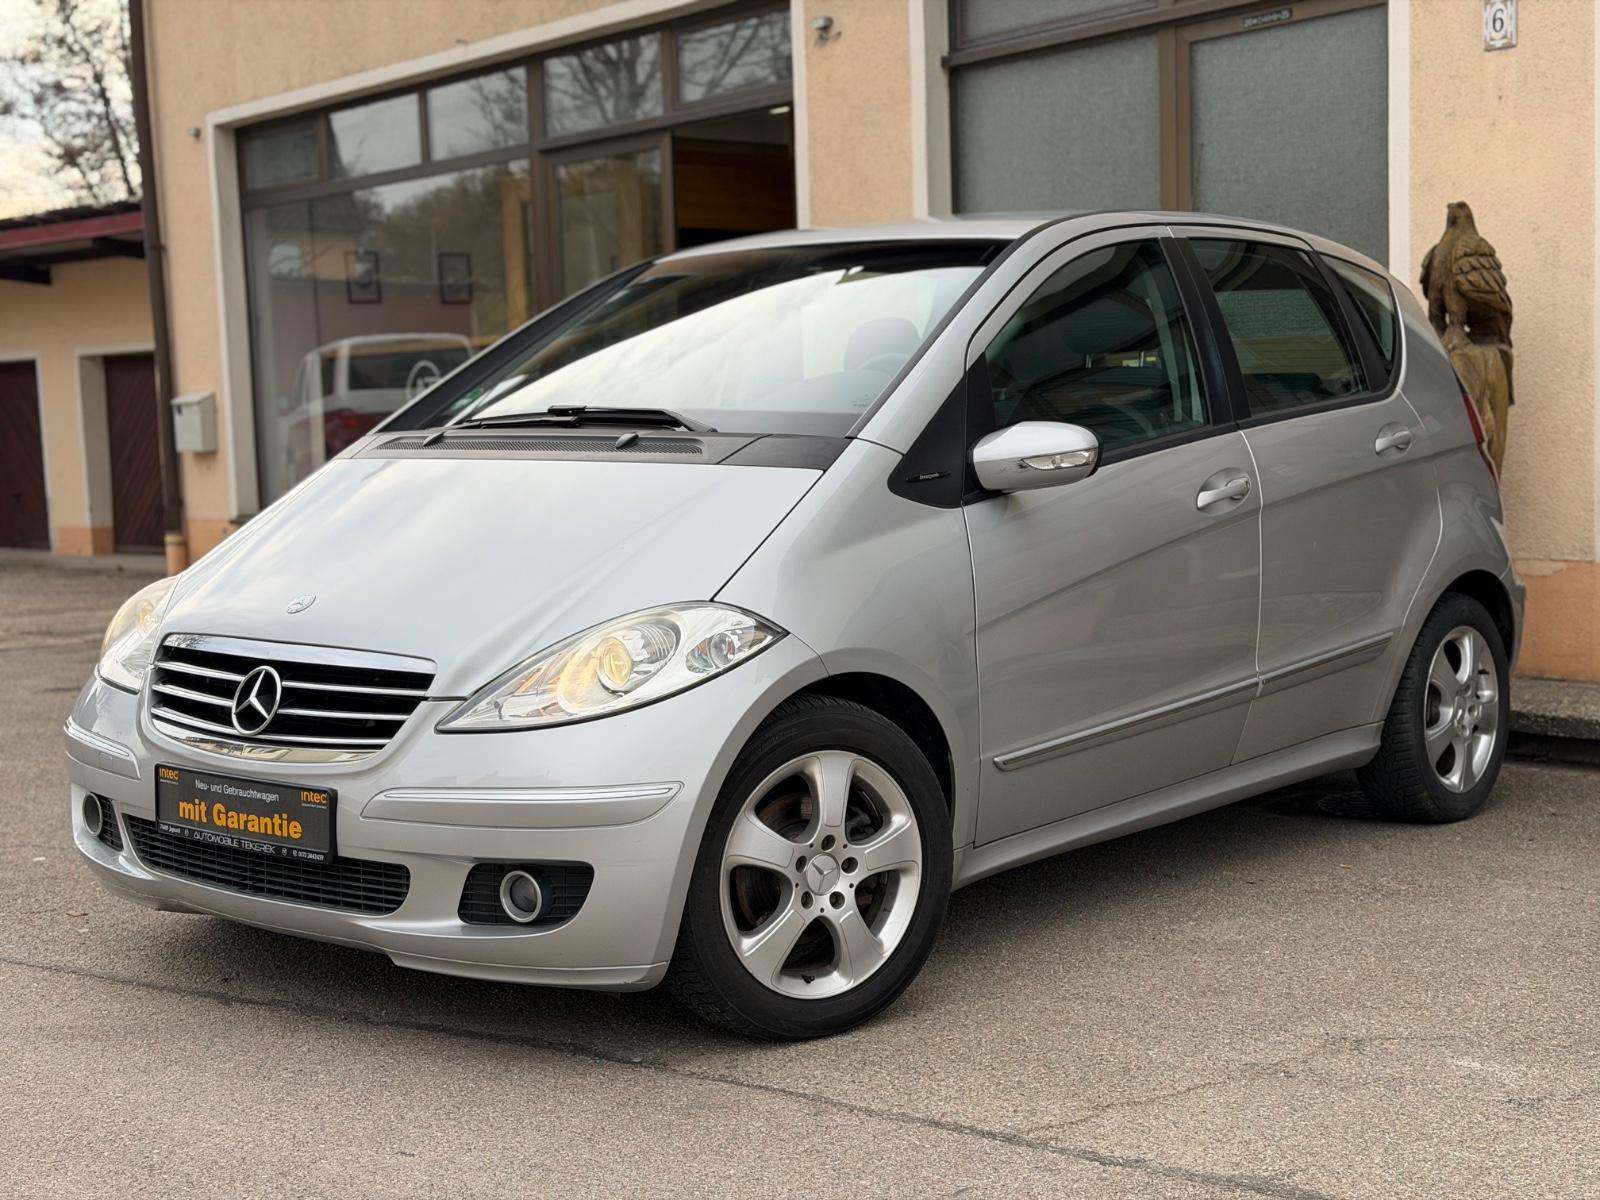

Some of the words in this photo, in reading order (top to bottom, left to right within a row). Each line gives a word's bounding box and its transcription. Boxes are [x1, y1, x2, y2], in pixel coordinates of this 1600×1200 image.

[1492, 8, 1505, 33] 6
[159, 767, 179, 780] intec
[195, 778, 209, 790] Neu-
[210, 783, 222, 793] und
[223, 784, 279, 803] Gebrauchtwagen
[300, 790, 328, 804] intec
[179, 798, 207, 823] mit
[212, 802, 302, 839] Garantie
[193, 831, 239, 847] AUTOMOBILE
